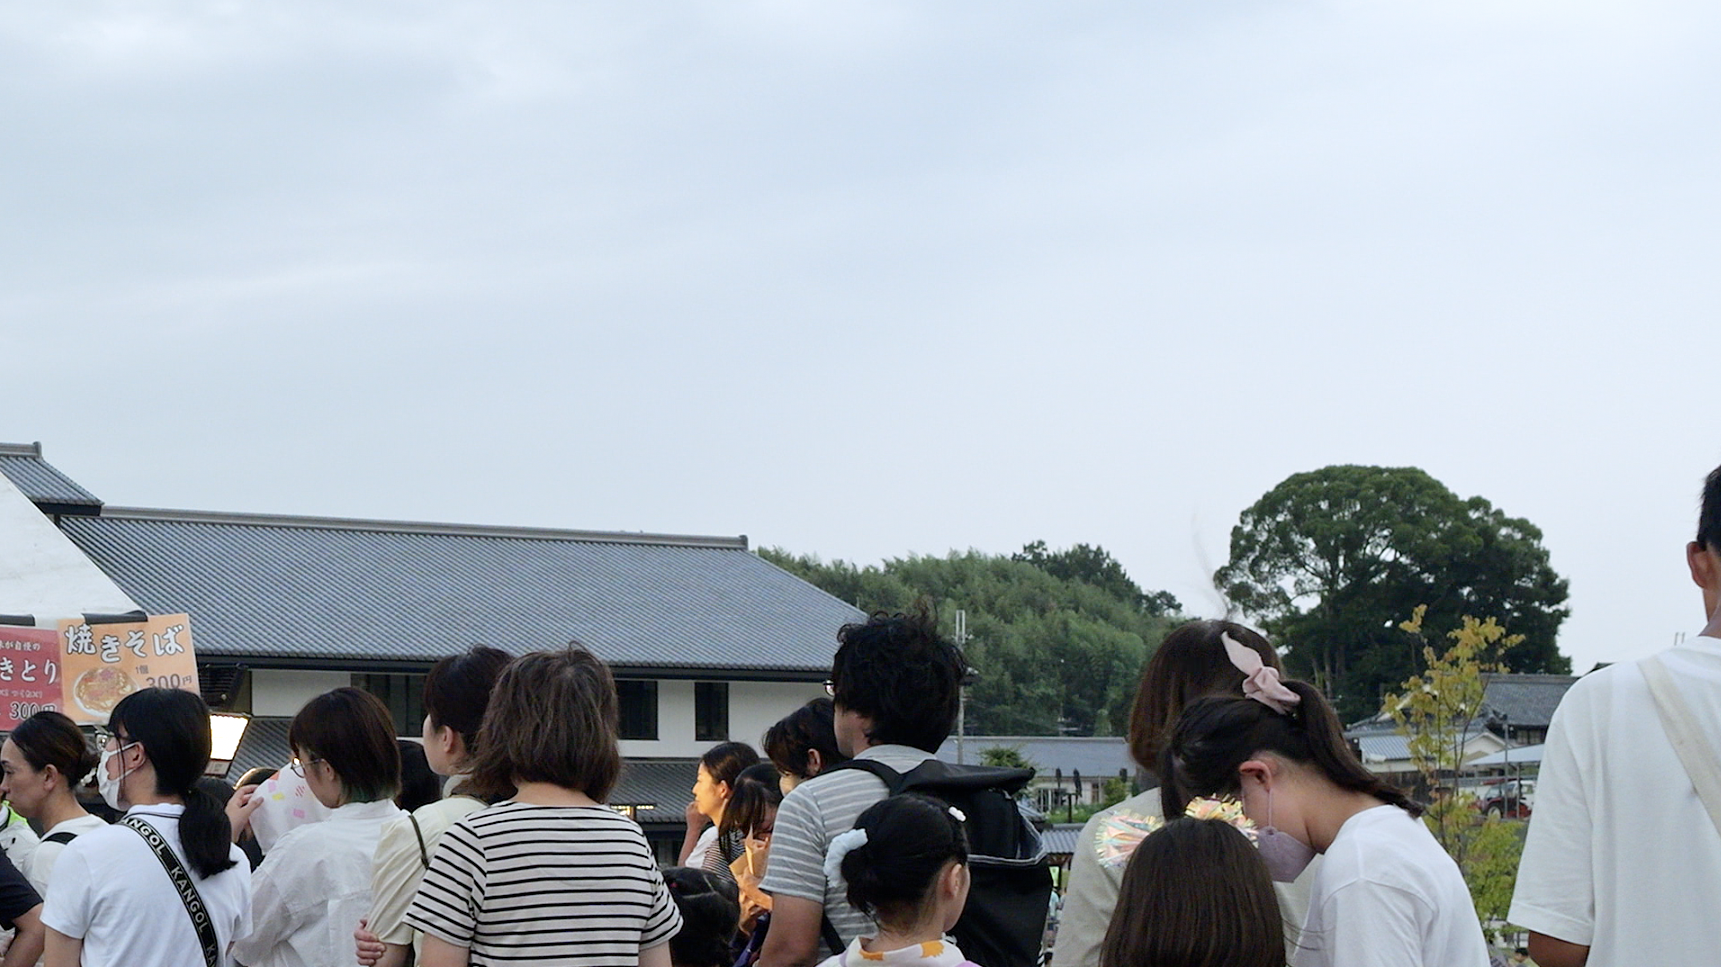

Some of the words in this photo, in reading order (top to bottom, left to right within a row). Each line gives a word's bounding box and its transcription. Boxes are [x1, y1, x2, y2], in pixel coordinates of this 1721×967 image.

[65, 624, 185, 664] 焼きそば
[171, 867, 209, 933] KANGOL
